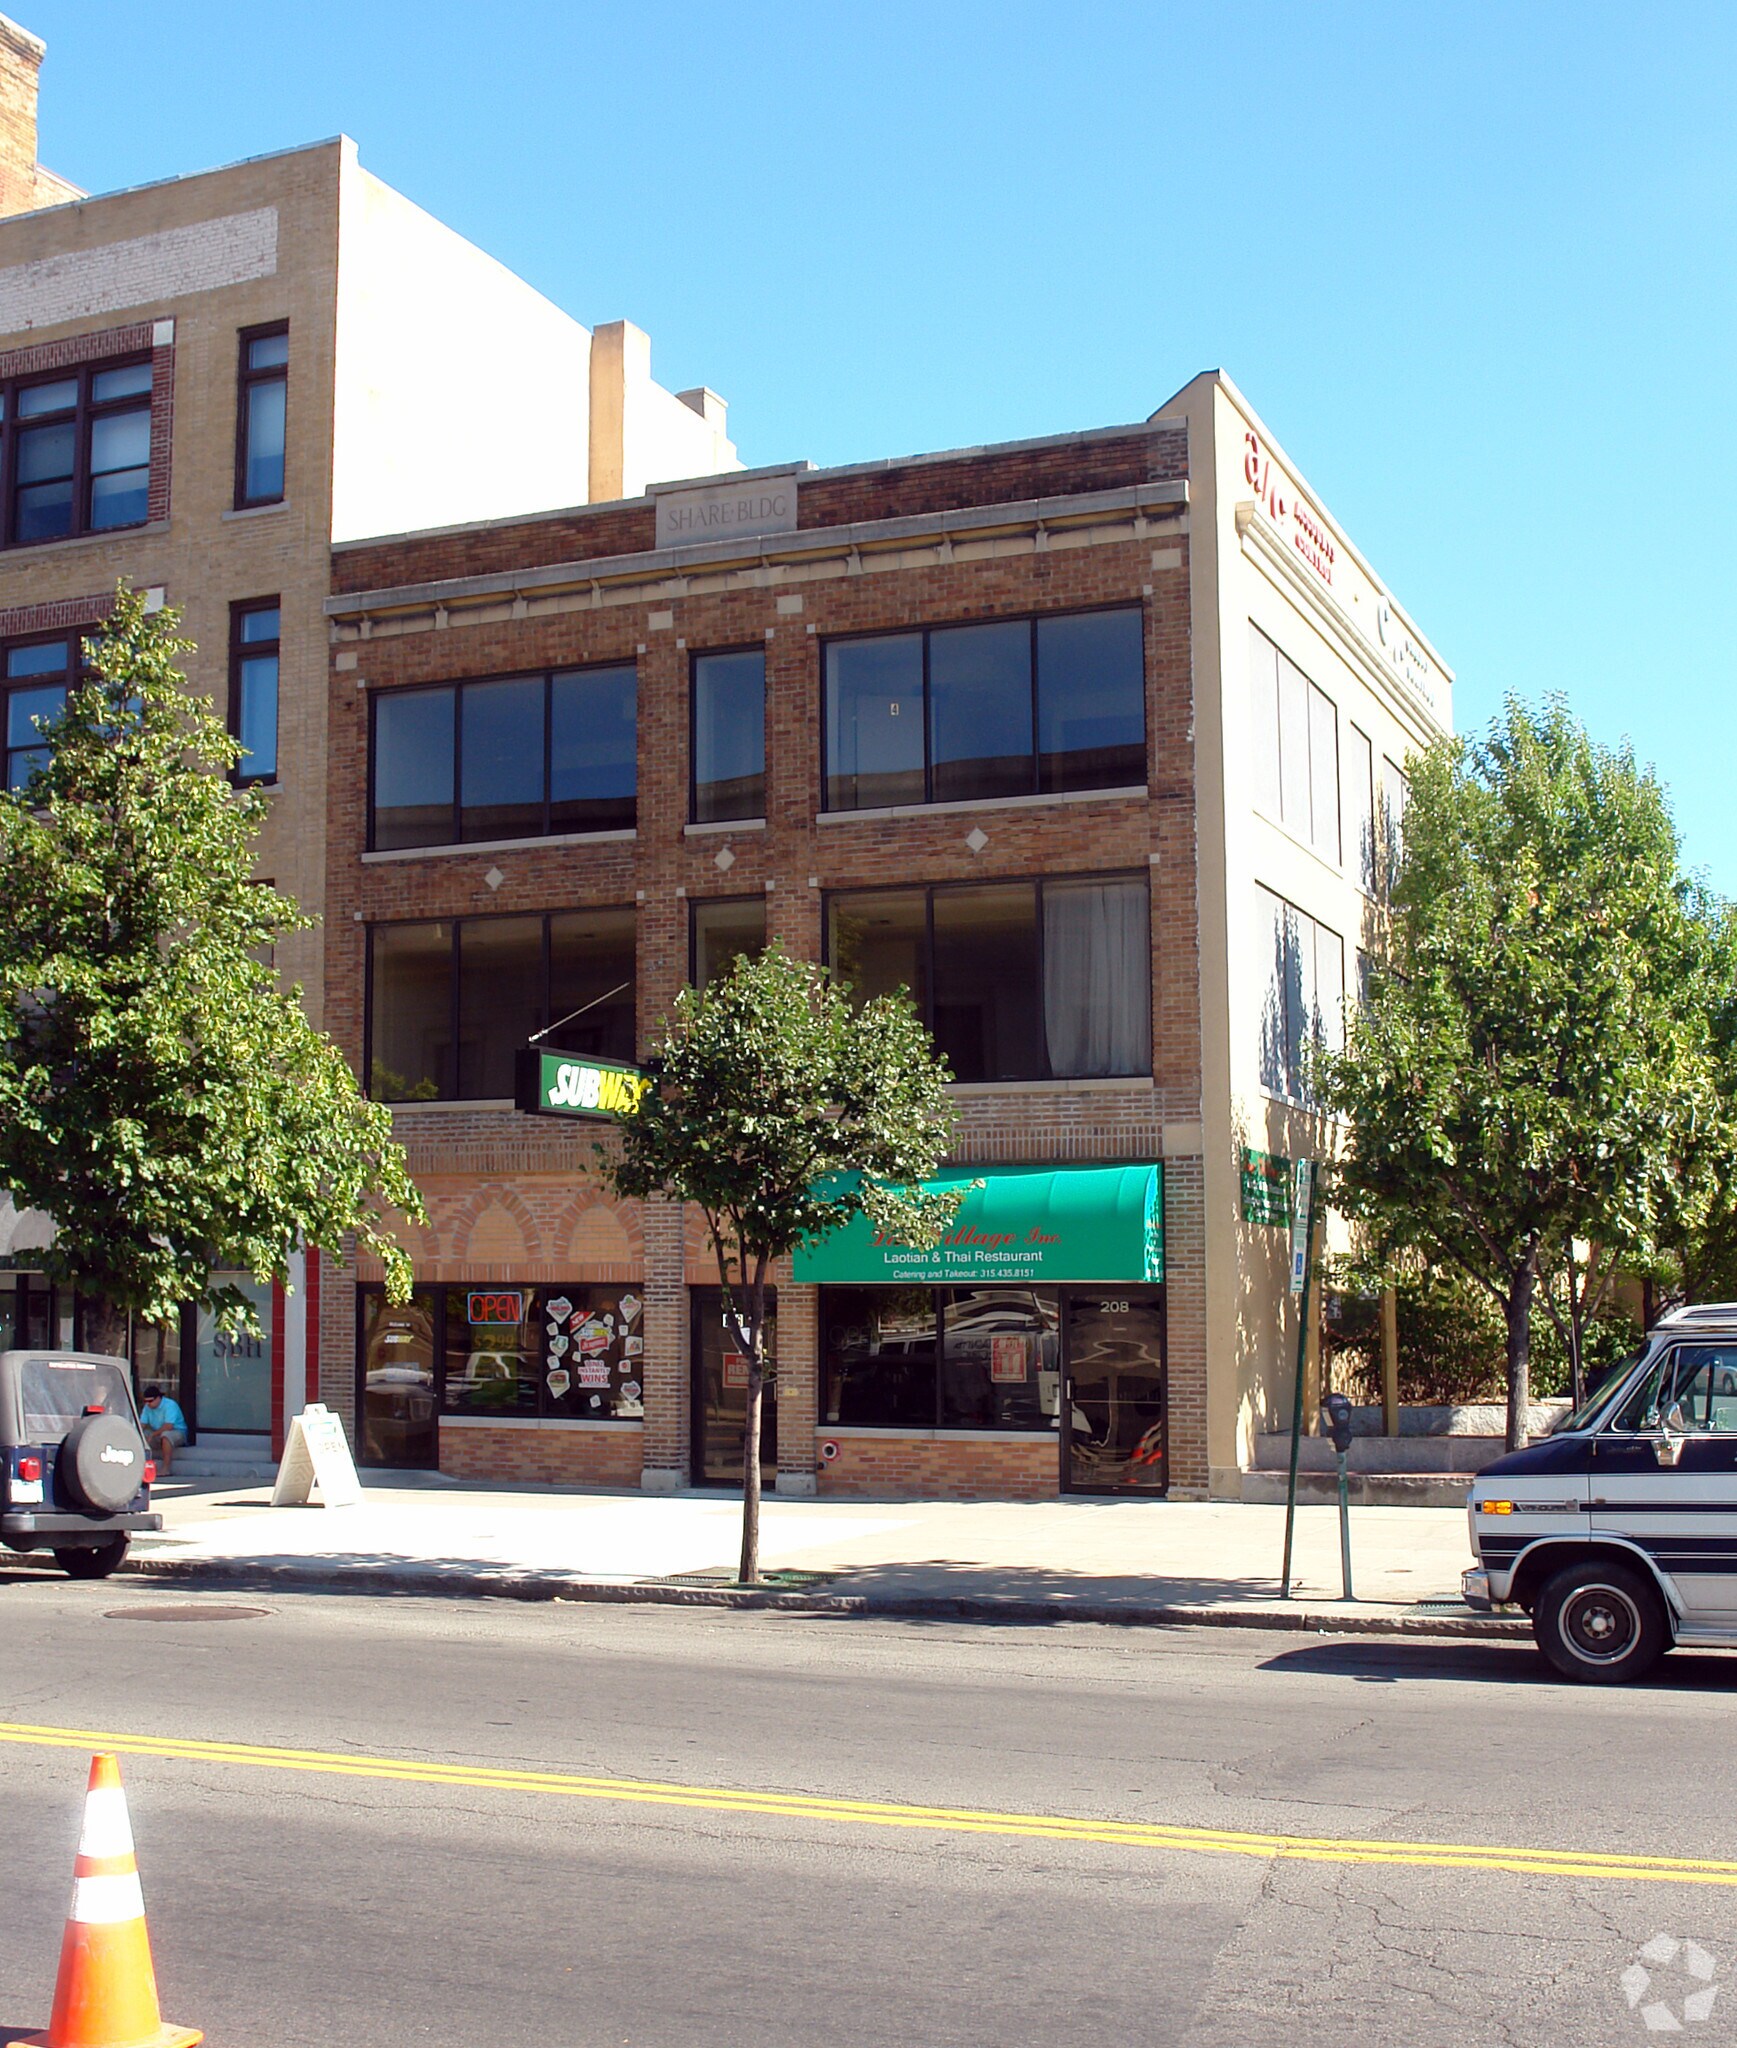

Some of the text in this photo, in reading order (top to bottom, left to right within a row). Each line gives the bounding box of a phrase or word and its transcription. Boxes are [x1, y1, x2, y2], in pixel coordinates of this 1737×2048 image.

[667, 495, 786, 532] SHARE BLDG
[930, 1225, 1016, 1251] illage
[1023, 1226, 1062, 1245] Inc.
[884, 1250, 1043, 1264] Laotian & Thai Restaurant
[893, 1268, 1035, 1280] Catering and Takeout: 315.435.8151
[470, 1295, 520, 1322] OPEN
[1100, 1301, 1129, 1314] 208
[213, 1332, 262, 1358] SBH
[581, 1375, 608, 1383] WINS
[728, 1364, 749, 1376] REN
[101, 1445, 134, 1467] Jeep
